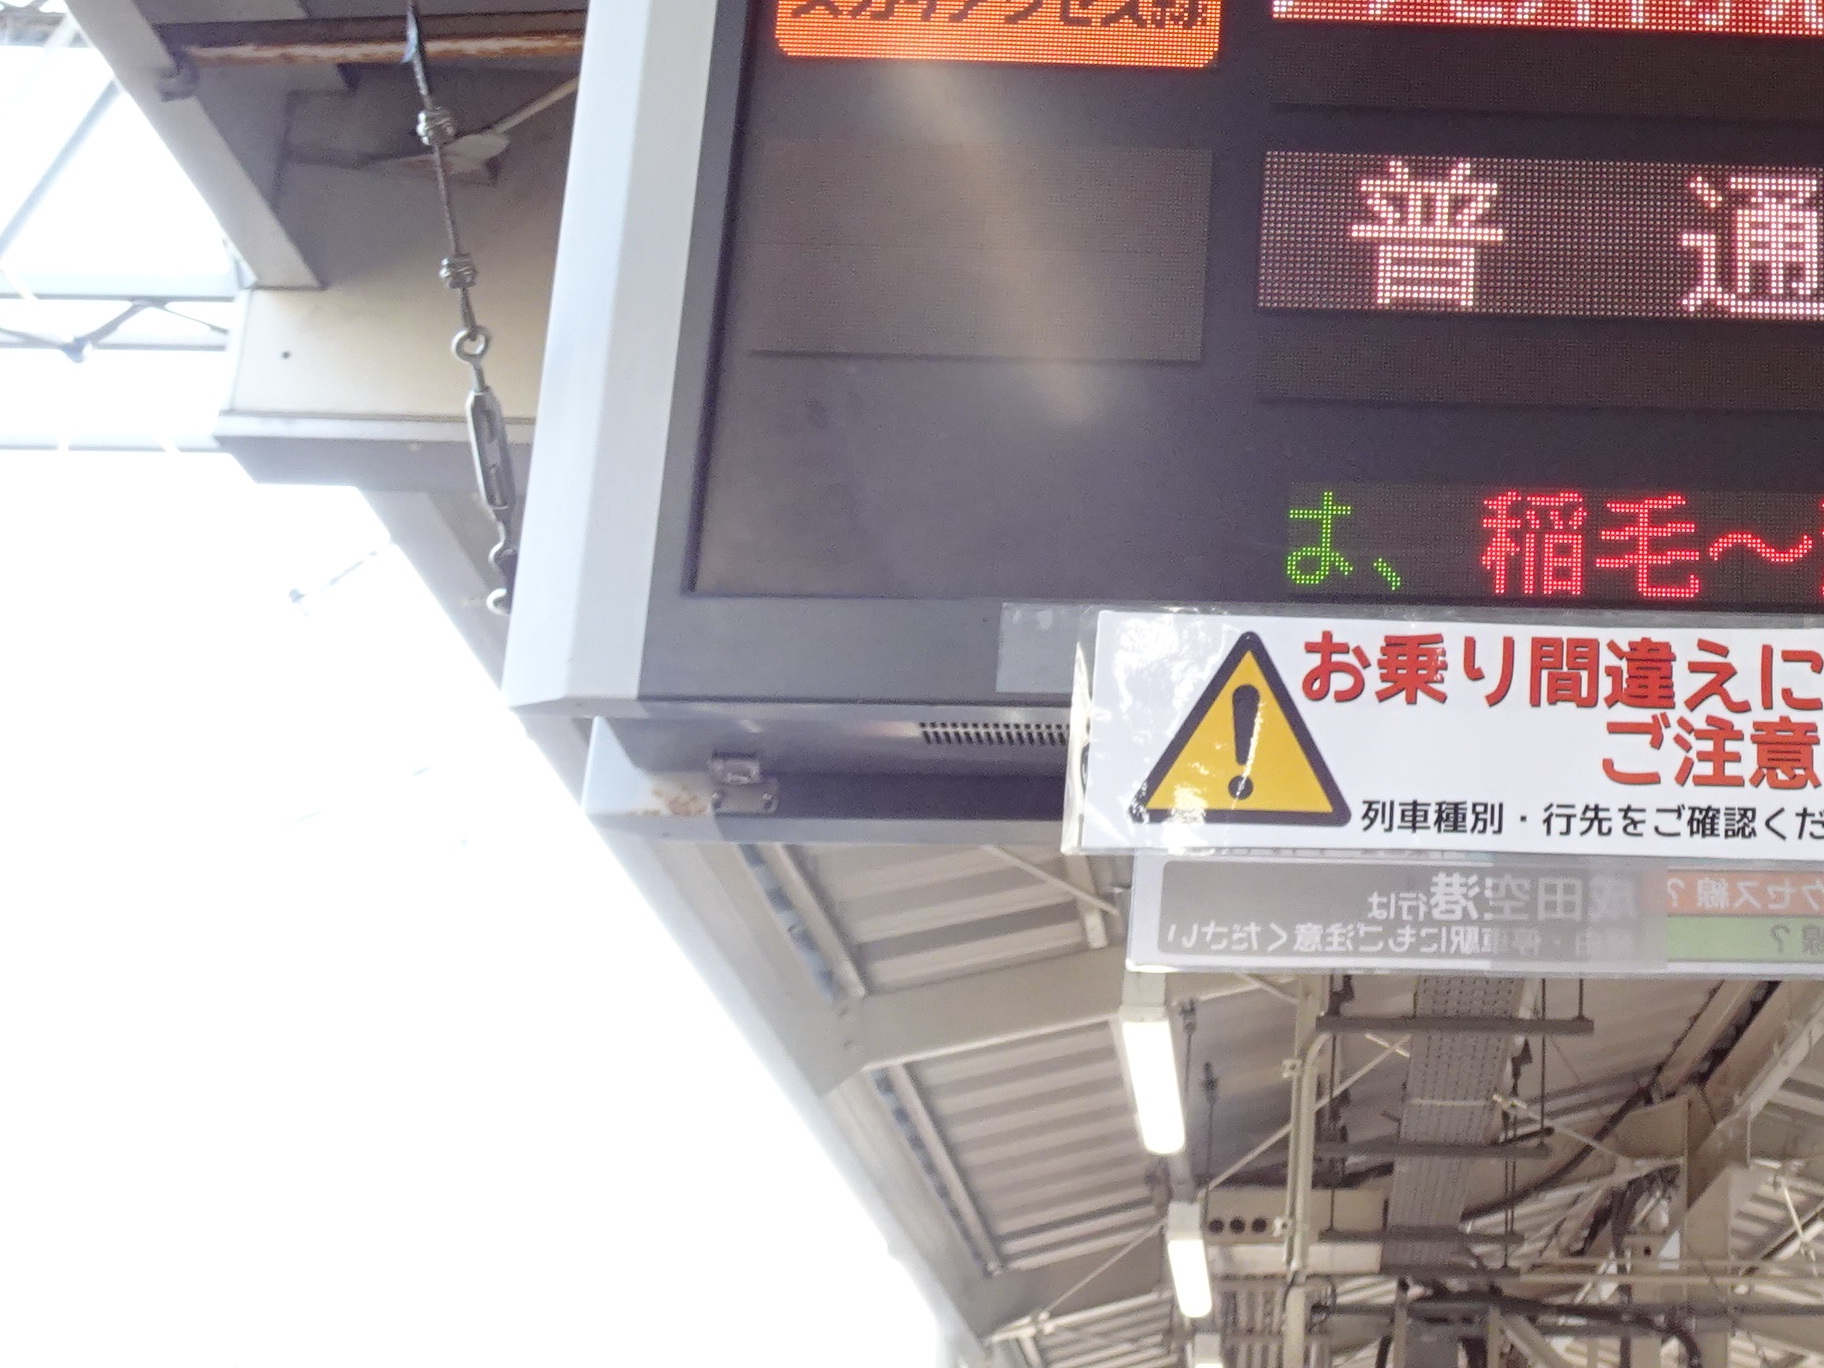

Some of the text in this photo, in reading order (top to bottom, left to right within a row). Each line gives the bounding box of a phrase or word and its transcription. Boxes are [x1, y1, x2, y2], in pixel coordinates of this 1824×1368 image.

[1301, 632, 1824, 712] お乗り間違えに
